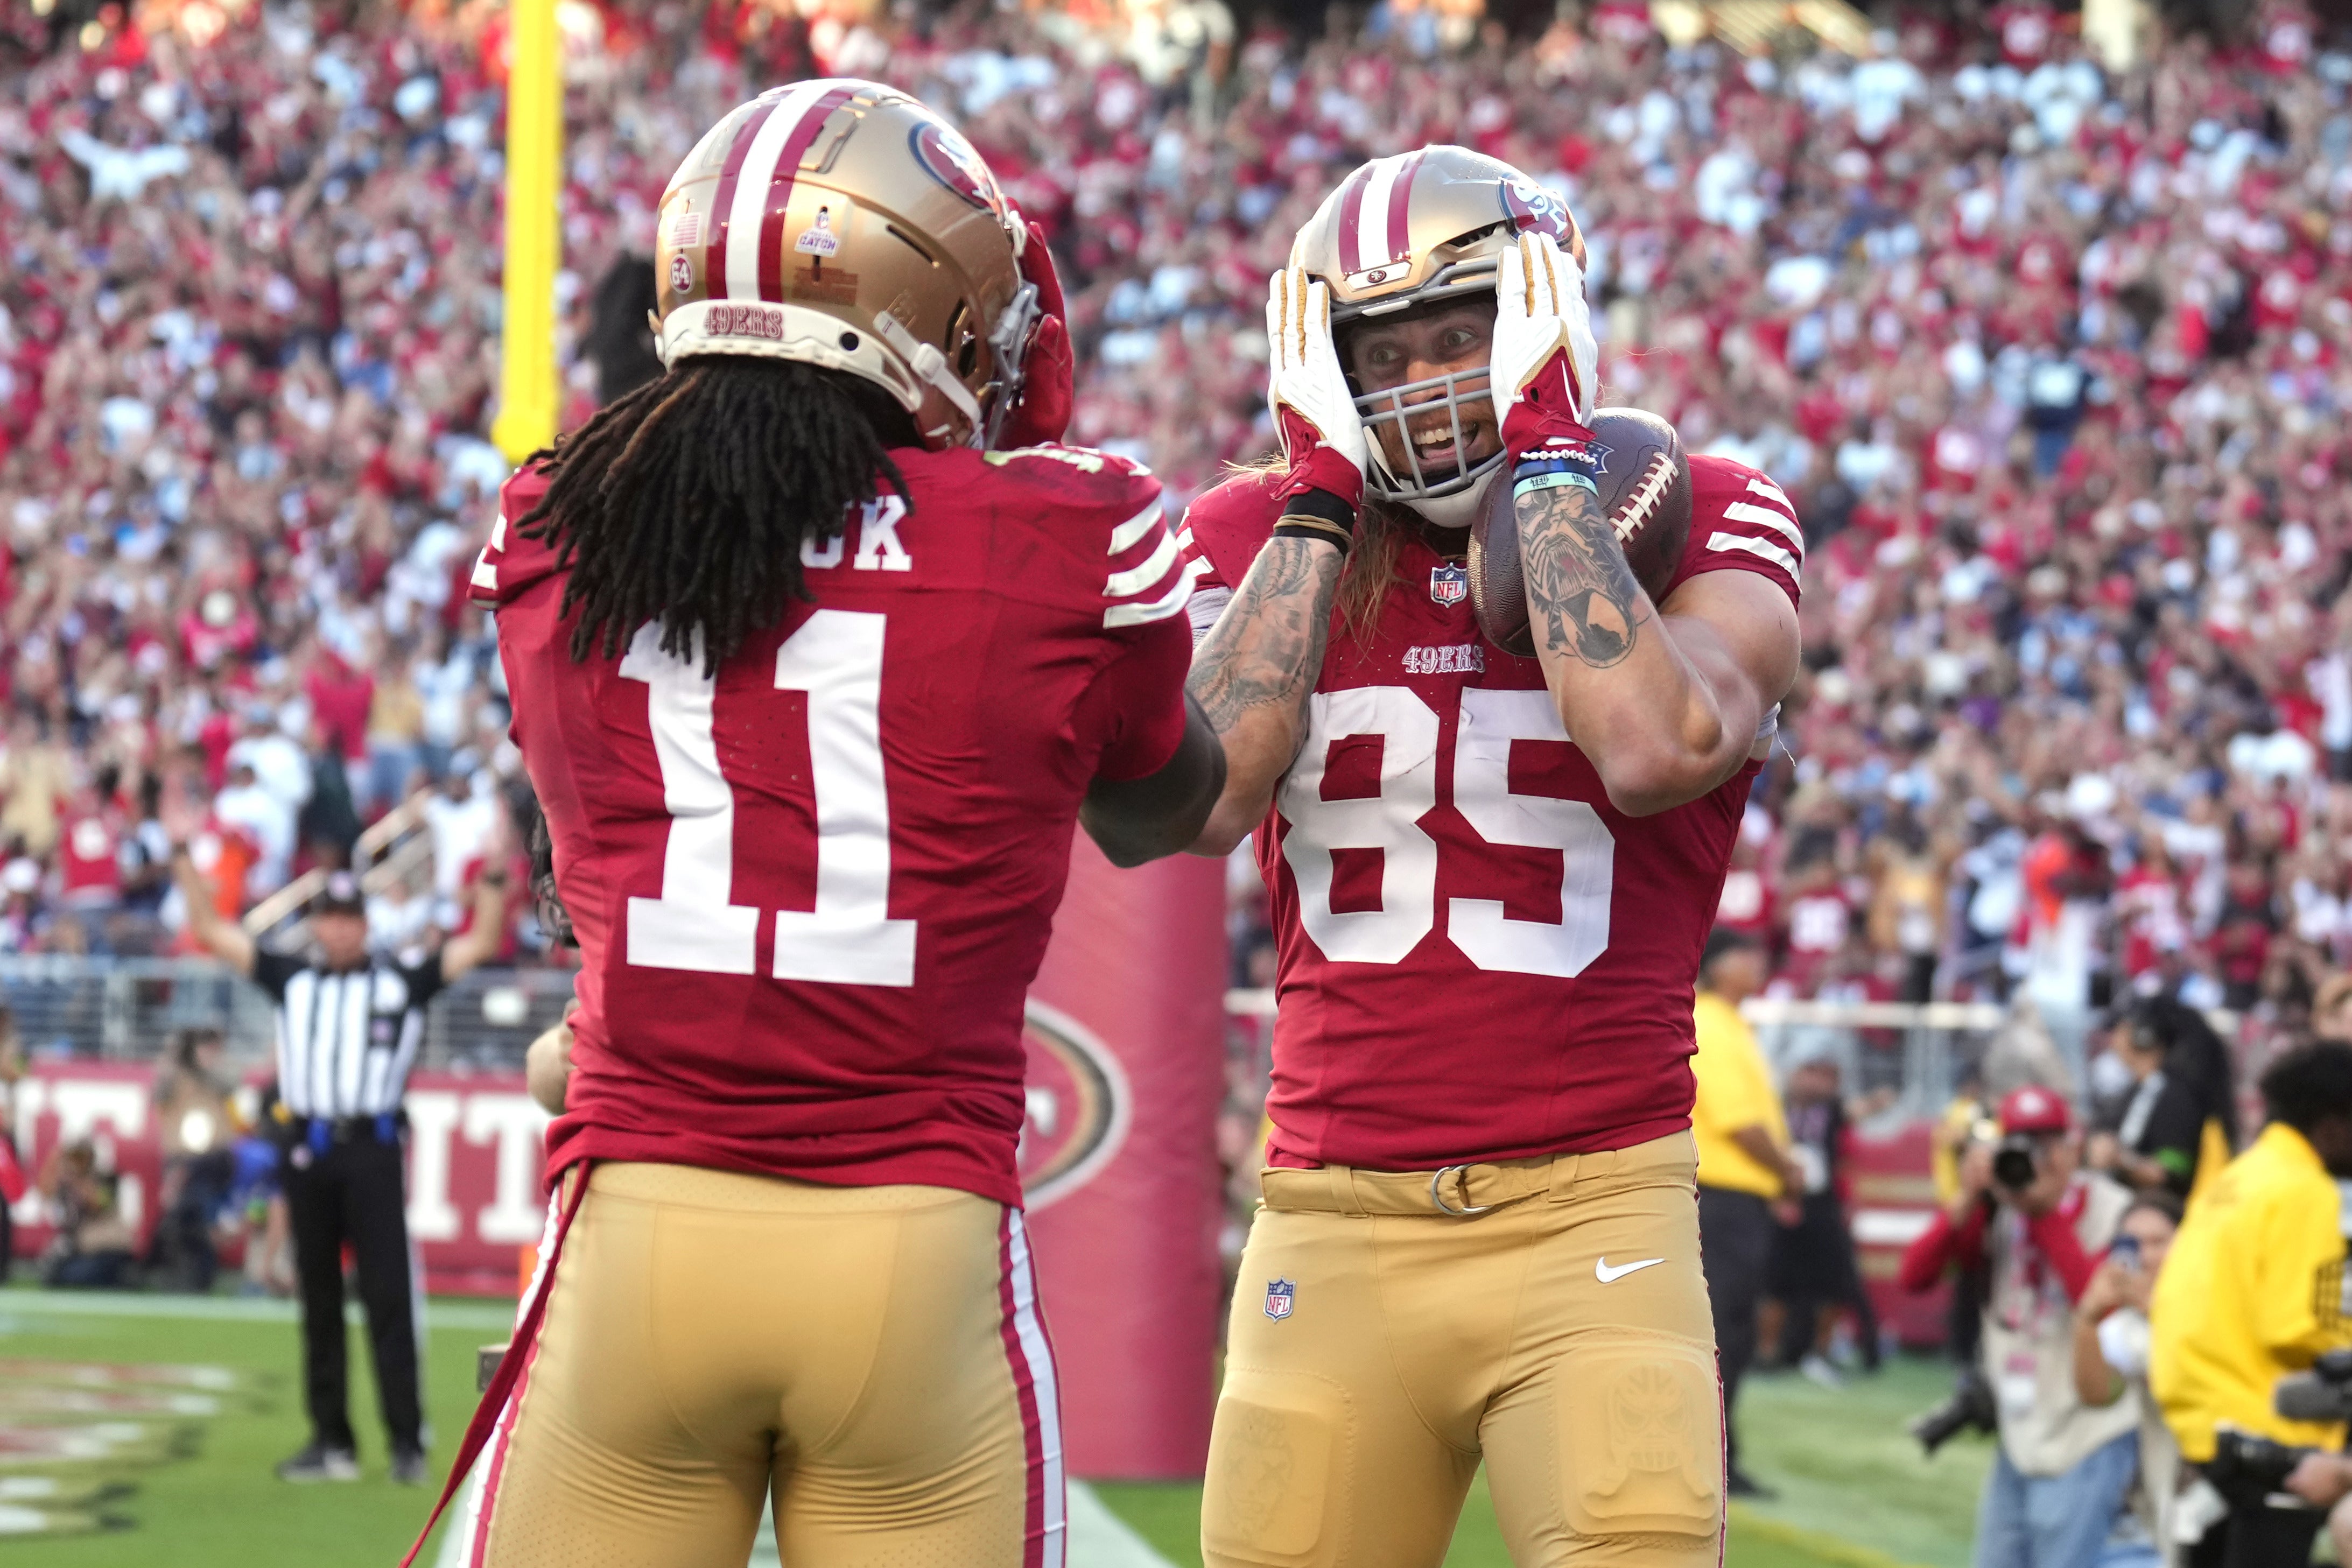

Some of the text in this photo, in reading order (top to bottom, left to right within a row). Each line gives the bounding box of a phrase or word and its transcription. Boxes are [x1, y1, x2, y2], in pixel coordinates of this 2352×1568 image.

[671, 262, 691, 286] 64
[703, 305, 783, 340] 49ERS
[1437, 582, 1461, 599] NFL
[1401, 643, 1485, 674] 49ERS
[619, 608, 917, 987] 11
[1276, 686, 1616, 979] 85
[1267, 1296, 1288, 1314] NFL
